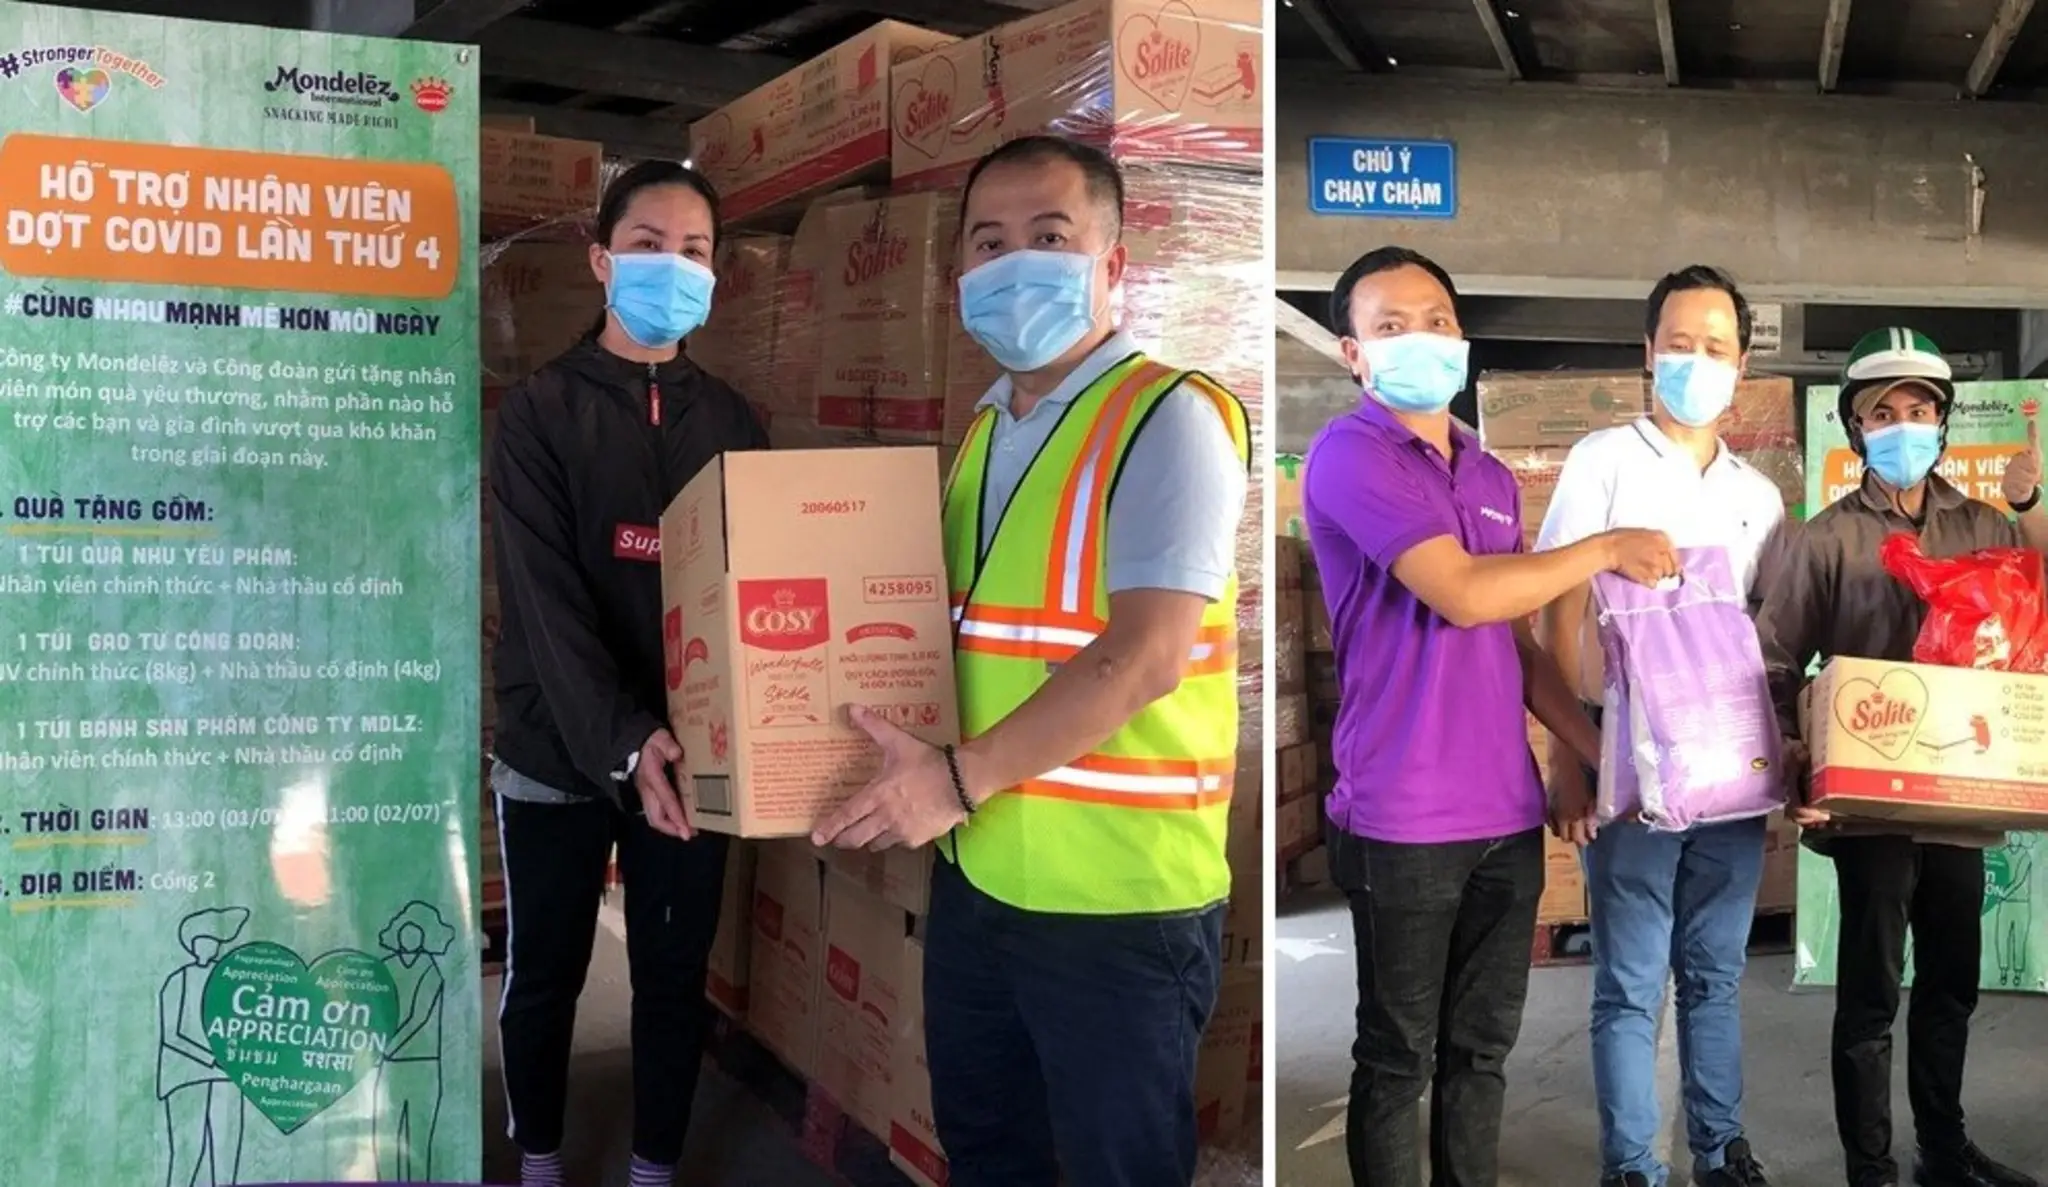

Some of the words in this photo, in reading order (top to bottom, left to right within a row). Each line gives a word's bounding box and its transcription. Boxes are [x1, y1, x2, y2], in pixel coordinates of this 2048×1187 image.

[1134, 39, 1191, 79] Solite
[1353, 145, 1393, 173] CHÚ
[1399, 145, 1412, 175] Ý
[109, 169, 190, 215] TRỢ
[204, 174, 311, 216] NHÂN
[325, 181, 411, 223] VIÊN
[1324, 178, 1377, 209] CHẠY
[1382, 176, 1442, 211] CHẬM
[7, 209, 91, 254] ĐỢT
[106, 216, 222, 257] COVID
[237, 216, 312, 262] LẦN
[325, 223, 405, 268] THỨ
[415, 236, 441, 270] 4
[52, 352, 71, 372] ty
[185, 357, 207, 375] và
[214, 358, 263, 381] Công
[269, 360, 318, 380] đoàn
[361, 365, 402, 386] tặng
[409, 366, 456, 386] nhân
[46, 381, 92, 400] món
[98, 382, 136, 405] quà
[142, 385, 179, 406] yêu
[185, 386, 268, 410] thương,
[334, 390, 384, 413] phần
[389, 394, 424, 412] nào
[430, 391, 453, 413] hỗ
[14, 411, 48, 432] trợ
[53, 411, 87, 430] các
[92, 412, 130, 434] bạn
[136, 414, 160, 433] và
[165, 415, 195, 437] gia
[201, 416, 246, 435] đình
[252, 420, 302, 440] vượt
[307, 423, 344, 442] qua
[349, 420, 386, 440] khó
[390, 421, 437, 441] khăn
[131, 444, 187, 467] trong
[192, 445, 227, 466] giai
[233, 446, 284, 468] đoạn
[289, 449, 329, 470] này.
[14, 490, 64, 519] QUÀ
[74, 493, 141, 524] TẶNG
[152, 492, 214, 521] GỒM:
[20, 546, 28, 564] 1
[36, 540, 73, 564] TÚI
[81, 541, 124, 565] QUÀ
[132, 546, 175, 565] NHU
[53, 575, 101, 596] viên
[104, 574, 159, 596] chính
[166, 574, 213, 596] thức
[237, 576, 277, 596] Nhà
[283, 574, 328, 597] thầu
[360, 575, 404, 599] định
[868, 580, 933, 597] 4258095
[747, 606, 822, 634] COSY
[18, 633, 27, 652] 1
[36, 627, 72, 652] TÚI
[26, 661, 84, 681] chính
[91, 661, 140, 681] thức
[145, 660, 196, 685] (8kg)
[220, 661, 260, 680] Nhà
[266, 658, 311, 680] thầu
[345, 660, 388, 681] định
[394, 659, 441, 682] (4kg)
[17, 721, 26, 740] 1
[35, 715, 72, 740] TÚI
[326, 716, 353, 734] TY
[361, 714, 423, 733] MDLZ:
[1852, 698, 1917, 732] Solite
[0, 750, 44, 771] hân
[51, 749, 96, 769] viên
[101, 748, 157, 768] chính
[164, 747, 211, 767] thức
[235, 746, 275, 765] Nhà
[281, 744, 325, 764] thầu
[358, 742, 403, 766] định
[21, 803, 79, 833] THỜI
[374, 803, 440, 826] (02/07)
[20, 873, 62, 899] ĐỊA
[73, 862, 143, 893] ĐIỂM:
[204, 870, 216, 889] 2
[222, 966, 298, 985] Appreciation
[232, 982, 309, 1022] Cảm
[323, 999, 370, 1028] ơn
[208, 1016, 387, 1054] APPRECIATION
[242, 1072, 341, 1095] Penghargaan
